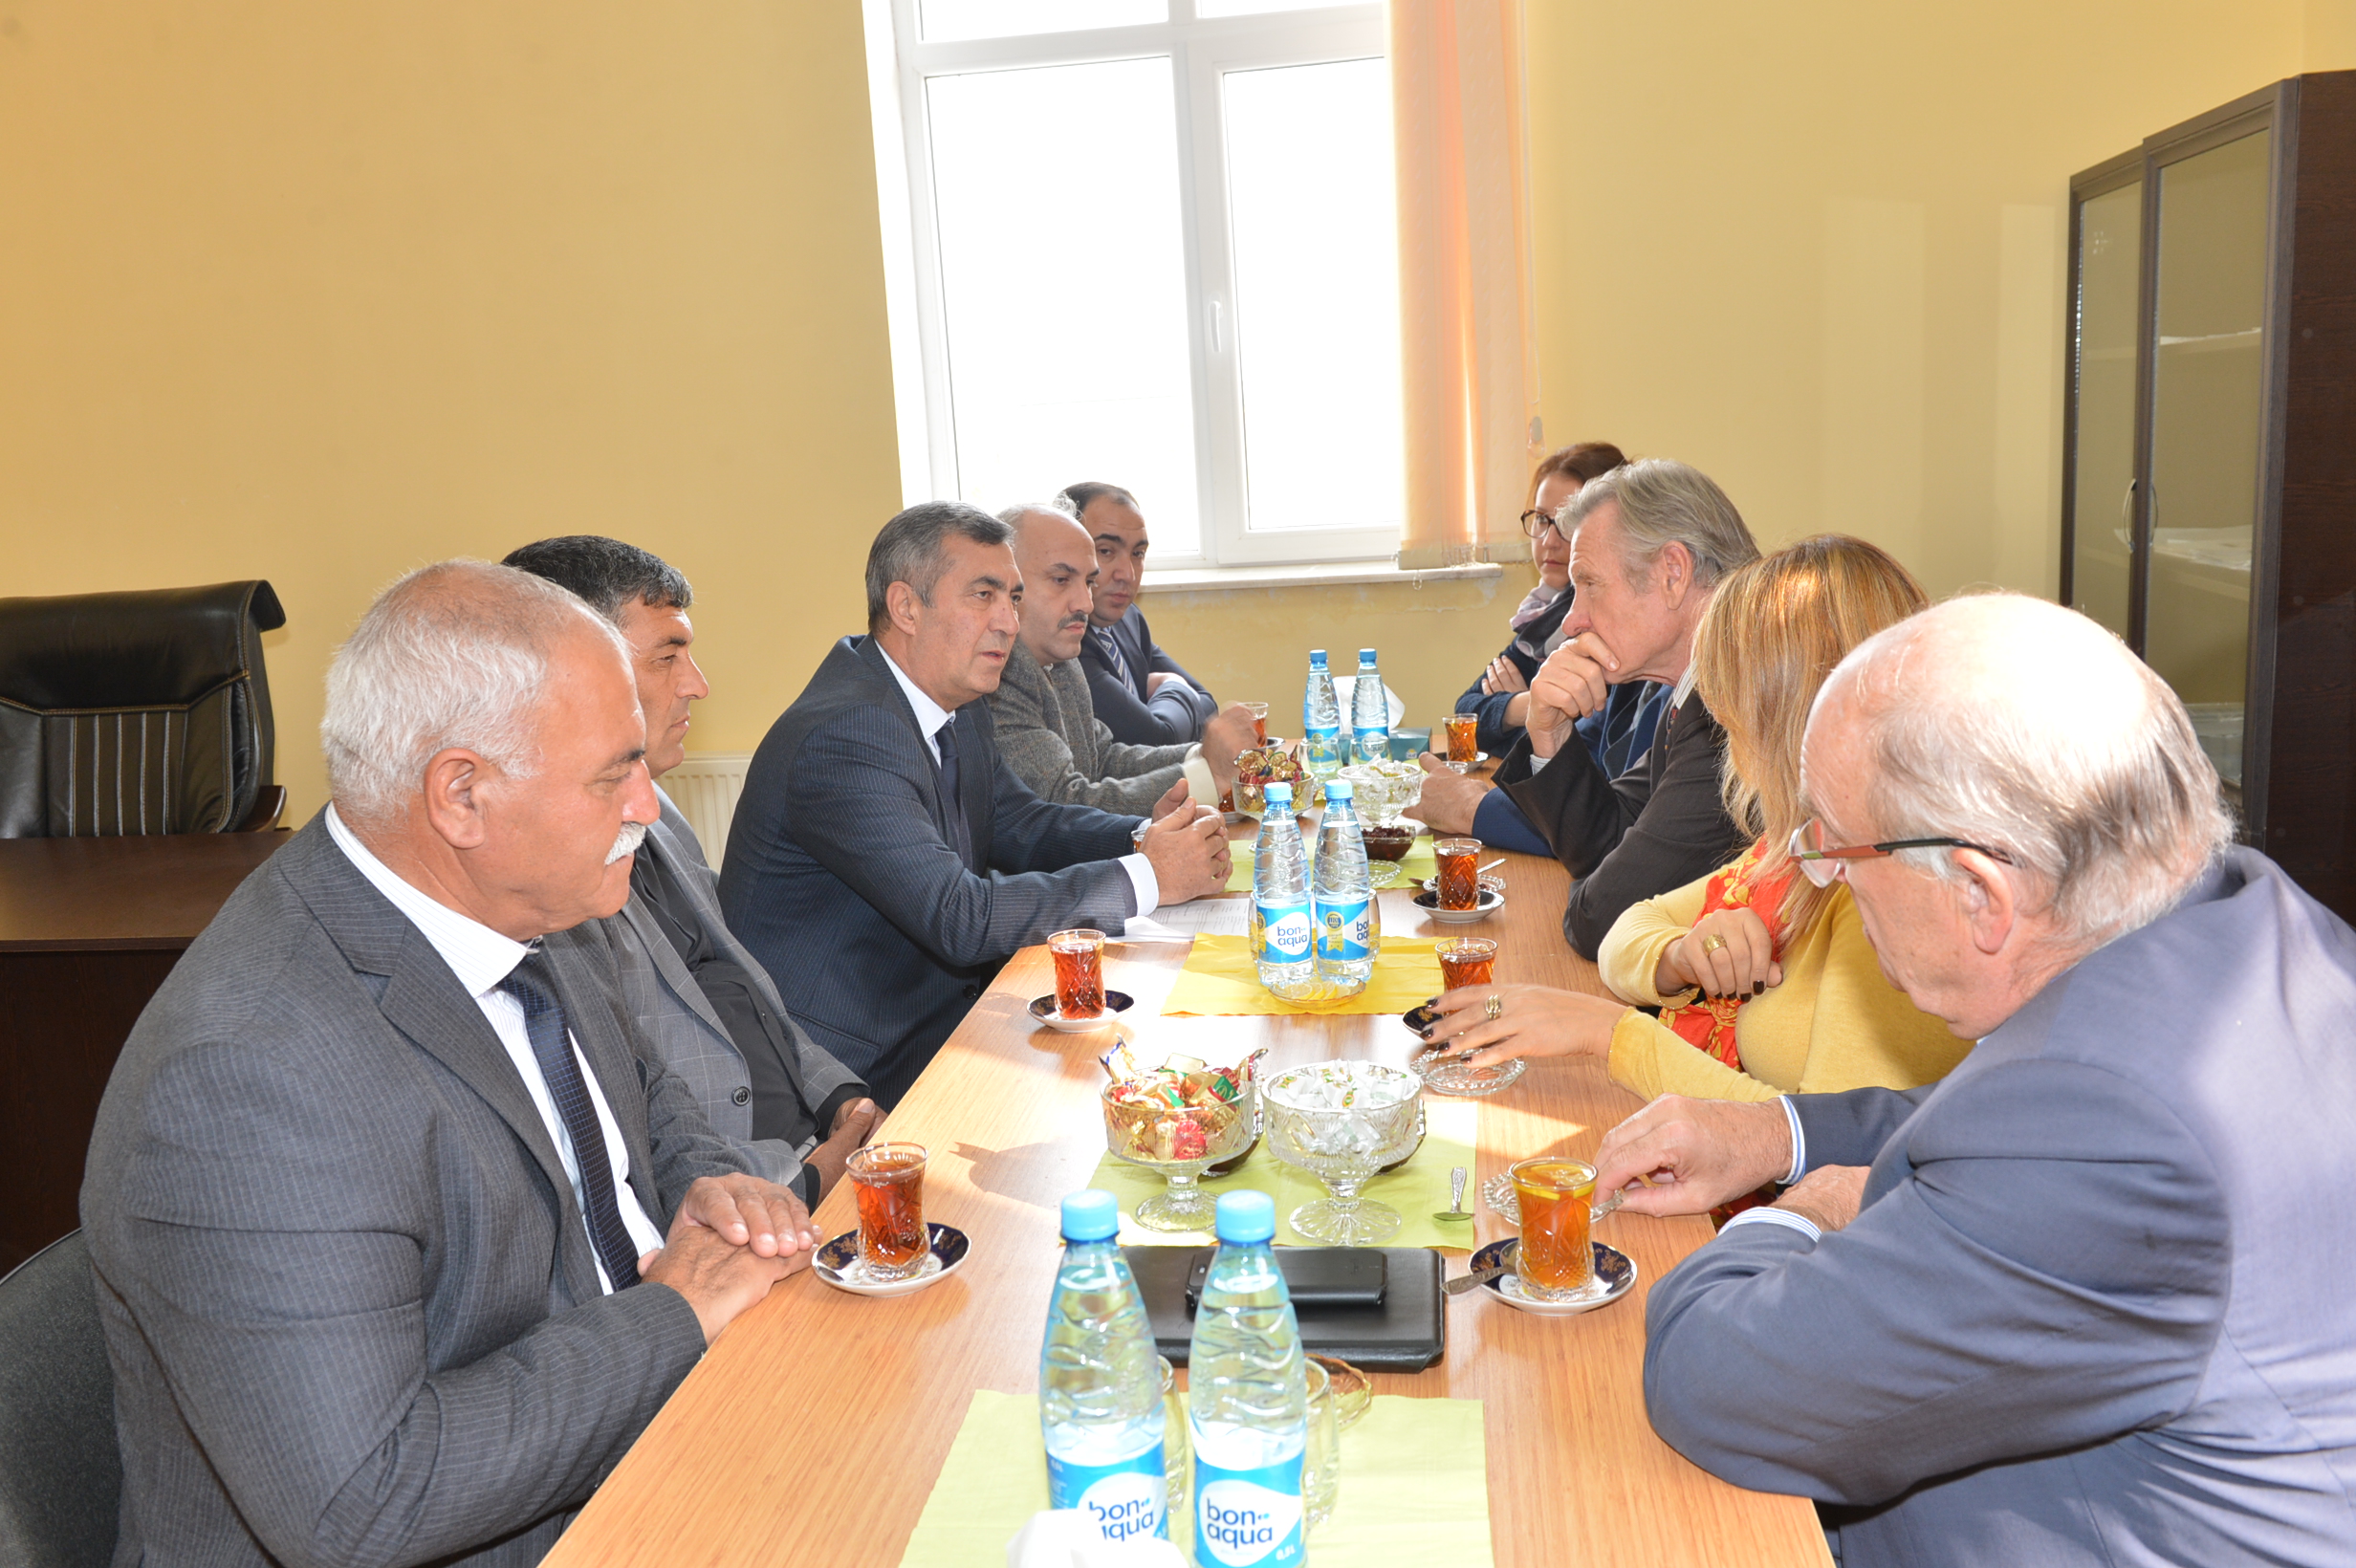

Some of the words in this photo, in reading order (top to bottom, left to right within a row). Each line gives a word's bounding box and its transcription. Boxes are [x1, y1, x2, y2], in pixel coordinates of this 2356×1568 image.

[1276, 926, 1301, 937] bon
[1277, 934, 1308, 947] aqua
[1207, 1497, 1255, 1526] bon
[1207, 1523, 1273, 1550] aqua
